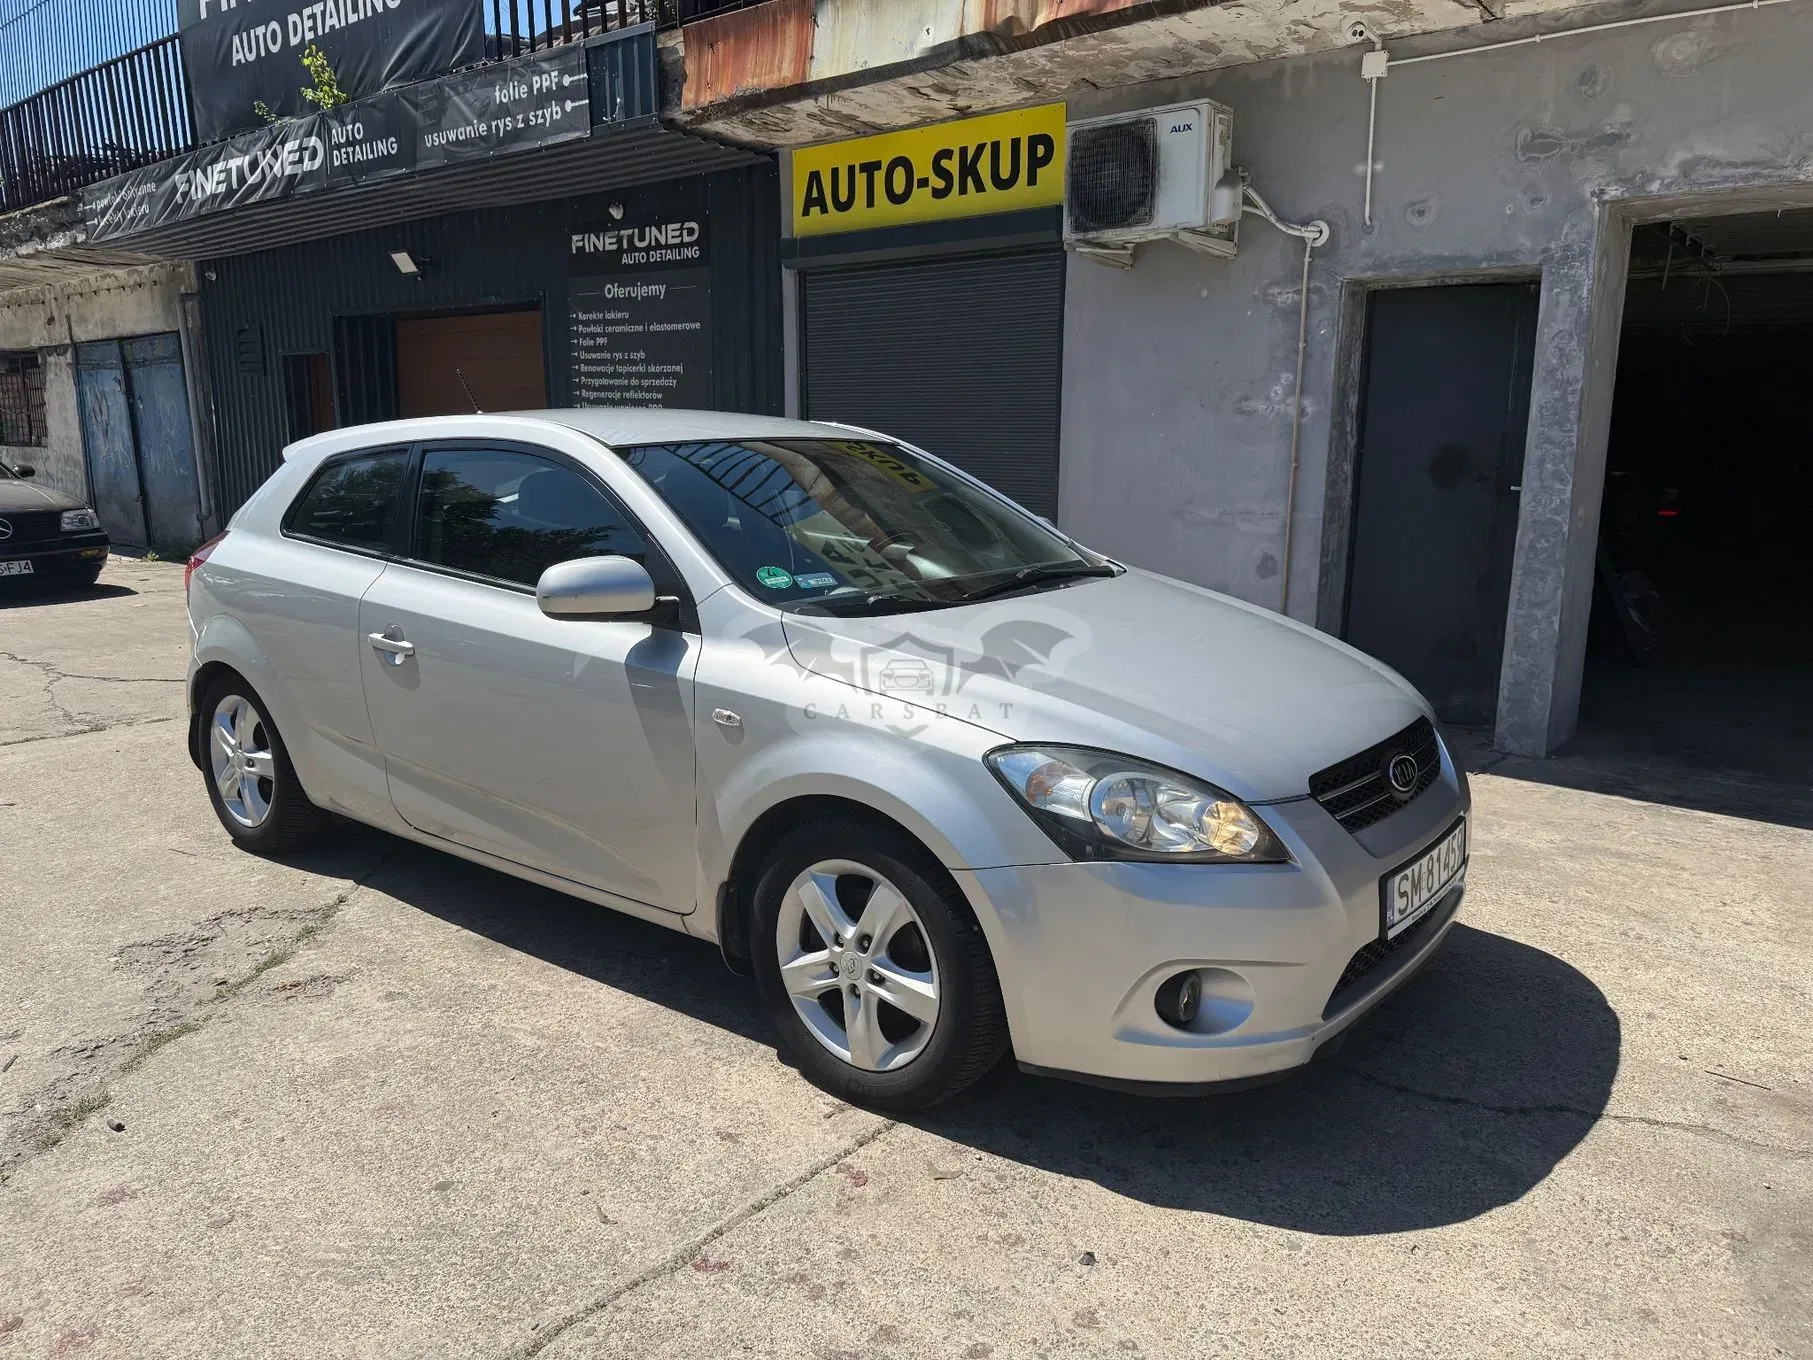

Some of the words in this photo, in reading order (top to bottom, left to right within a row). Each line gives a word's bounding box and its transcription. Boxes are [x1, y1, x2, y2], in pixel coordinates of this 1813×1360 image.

[232, 20, 282, 66] AUTO
[287, 0, 401, 46] DETAILI
[495, 81, 528, 104] folie
[532, 71, 559, 95] PPF
[425, 119, 487, 147] usuwanie
[491, 117, 512, 137] rys
[517, 113, 525, 128] z
[529, 100, 562, 127] szyb
[1170, 123, 1192, 134] AUX
[331, 122, 363, 146] AUTO
[333, 136, 398, 167] DETAILING
[175, 136, 324, 204] FINETUNED
[801, 133, 1055, 217] AUTO-SKUP
[571, 221, 700, 254] FINETUNED
[622, 252, 647, 264] AUTO
[650, 246, 700, 262] DETAILING
[604, 281, 666, 300] Oferujemy
[605, 310, 629, 319] lakieru
[605, 323, 643, 332] ceramiczne
[650, 322, 700, 332] elastomerowe
[580, 337, 594, 346] Folie
[596, 337, 608, 346] PPF
[580, 350, 611, 359] Usuwanie
[613, 352, 623, 361] rys
[630, 349, 645, 361] szyb
[580, 363, 614, 374] Renowacje
[616, 364, 646, 374] tapicerki
[581, 376, 628, 387] Przygotowanie
[630, 377, 639, 386] do
[581, 389, 621, 400] Regeneracje
[623, 390, 663, 400] reflektorów
[1398, 863, 1422, 917] SM
